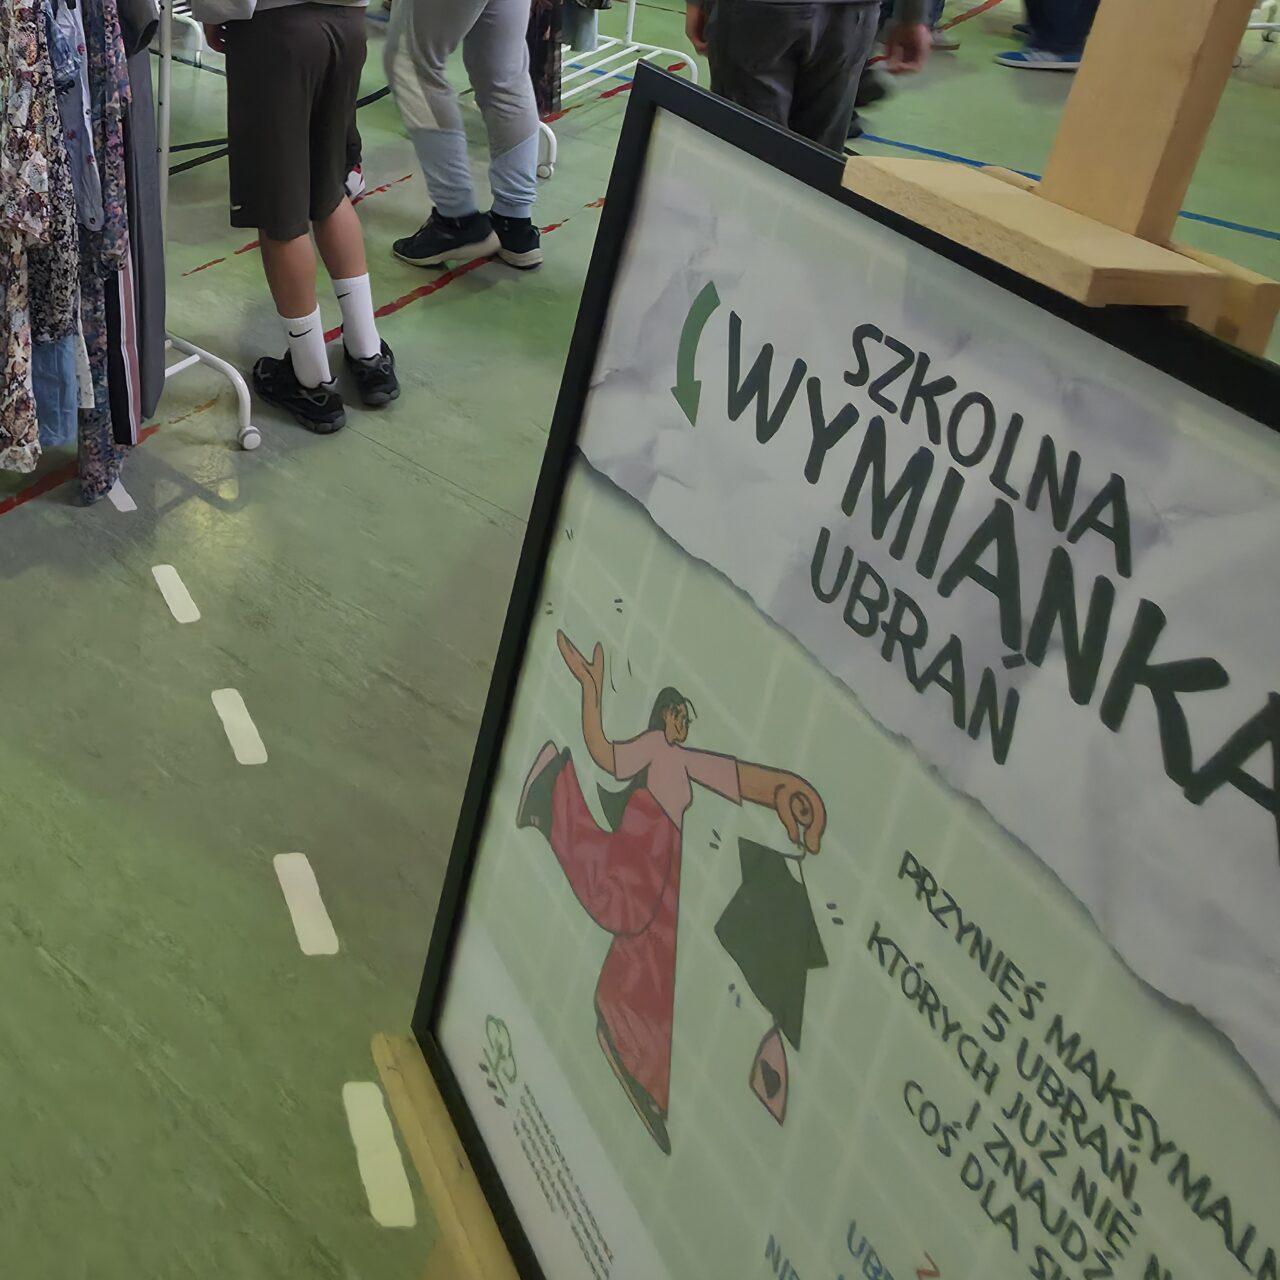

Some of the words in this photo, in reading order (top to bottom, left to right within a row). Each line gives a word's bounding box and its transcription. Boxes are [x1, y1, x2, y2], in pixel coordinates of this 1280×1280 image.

[843, 323, 1132, 579] SZKOLNA
[810, 526, 1026, 766] UBRAŃ
[897, 849, 1047, 1021] PRZYNIEŚ
[867, 921, 999, 1096] KTÓRYCH
[1001, 1091, 1068, 1176] JUŻ
[1071, 1166, 1138, 1260] NIE
[982, 1002, 1011, 1043] 5
[903, 1080, 963, 1158] COŚ
[960, 1151, 1019, 1252] DLA
[965, 1100, 981, 1131] I
